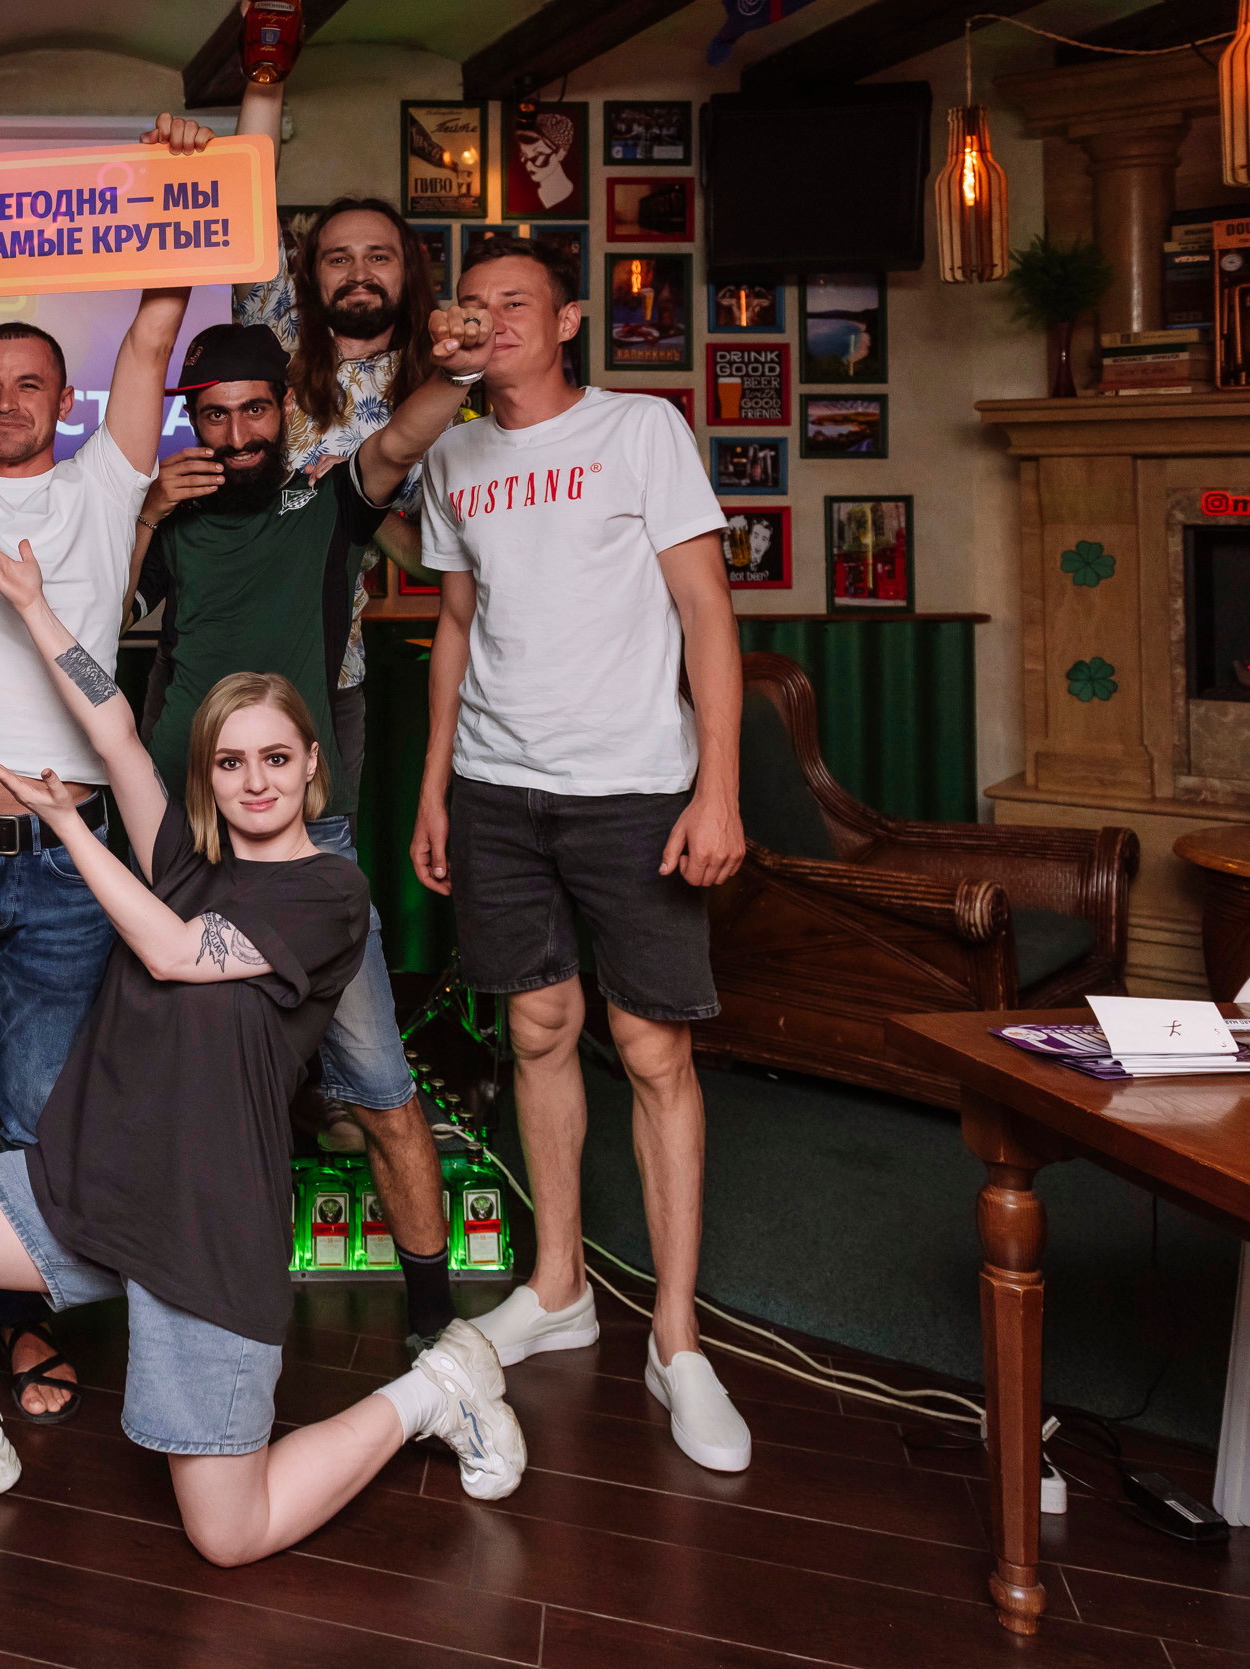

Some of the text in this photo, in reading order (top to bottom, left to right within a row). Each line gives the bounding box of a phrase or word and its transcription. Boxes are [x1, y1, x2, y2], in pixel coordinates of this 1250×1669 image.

[414, 178, 453, 194] ПИВО
[163, 180, 219, 211] МЫ
[92, 218, 230, 252] КРУТЫЕ!
[716, 350, 780, 362] DRINK
[716, 363, 781, 376] GOOD
[743, 377, 781, 388] BEER
[741, 398, 782, 409] GOOD
[741, 408, 782, 419] FRIENDS
